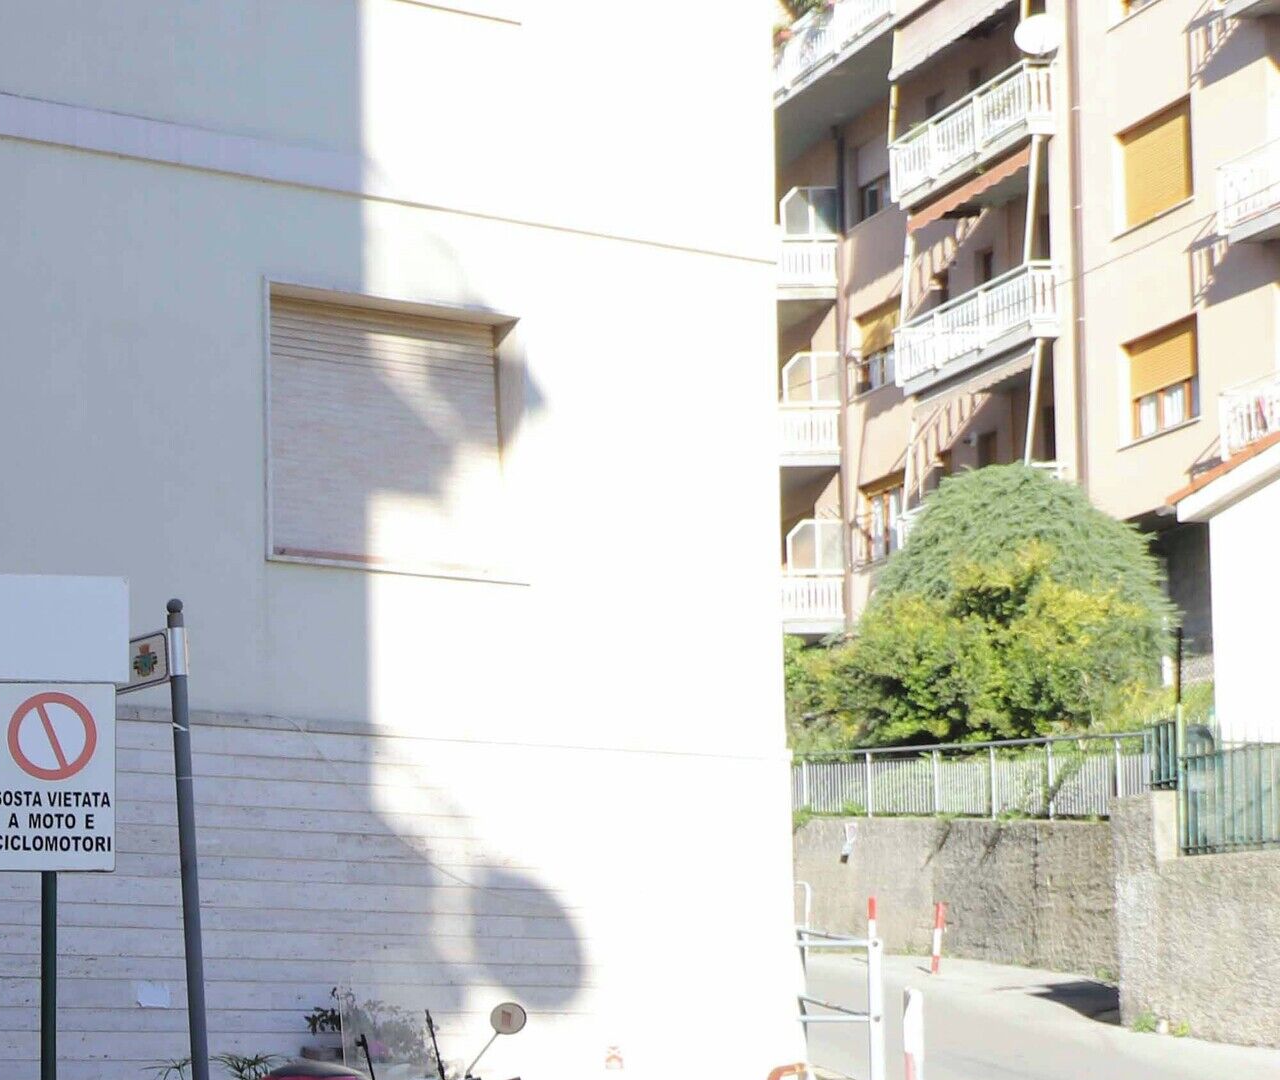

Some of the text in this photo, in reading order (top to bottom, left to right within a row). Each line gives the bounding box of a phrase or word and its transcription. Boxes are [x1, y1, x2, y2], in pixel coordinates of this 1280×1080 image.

[47, 791, 111, 808] VIETATA
[8, 813, 95, 829] A MOTO E
